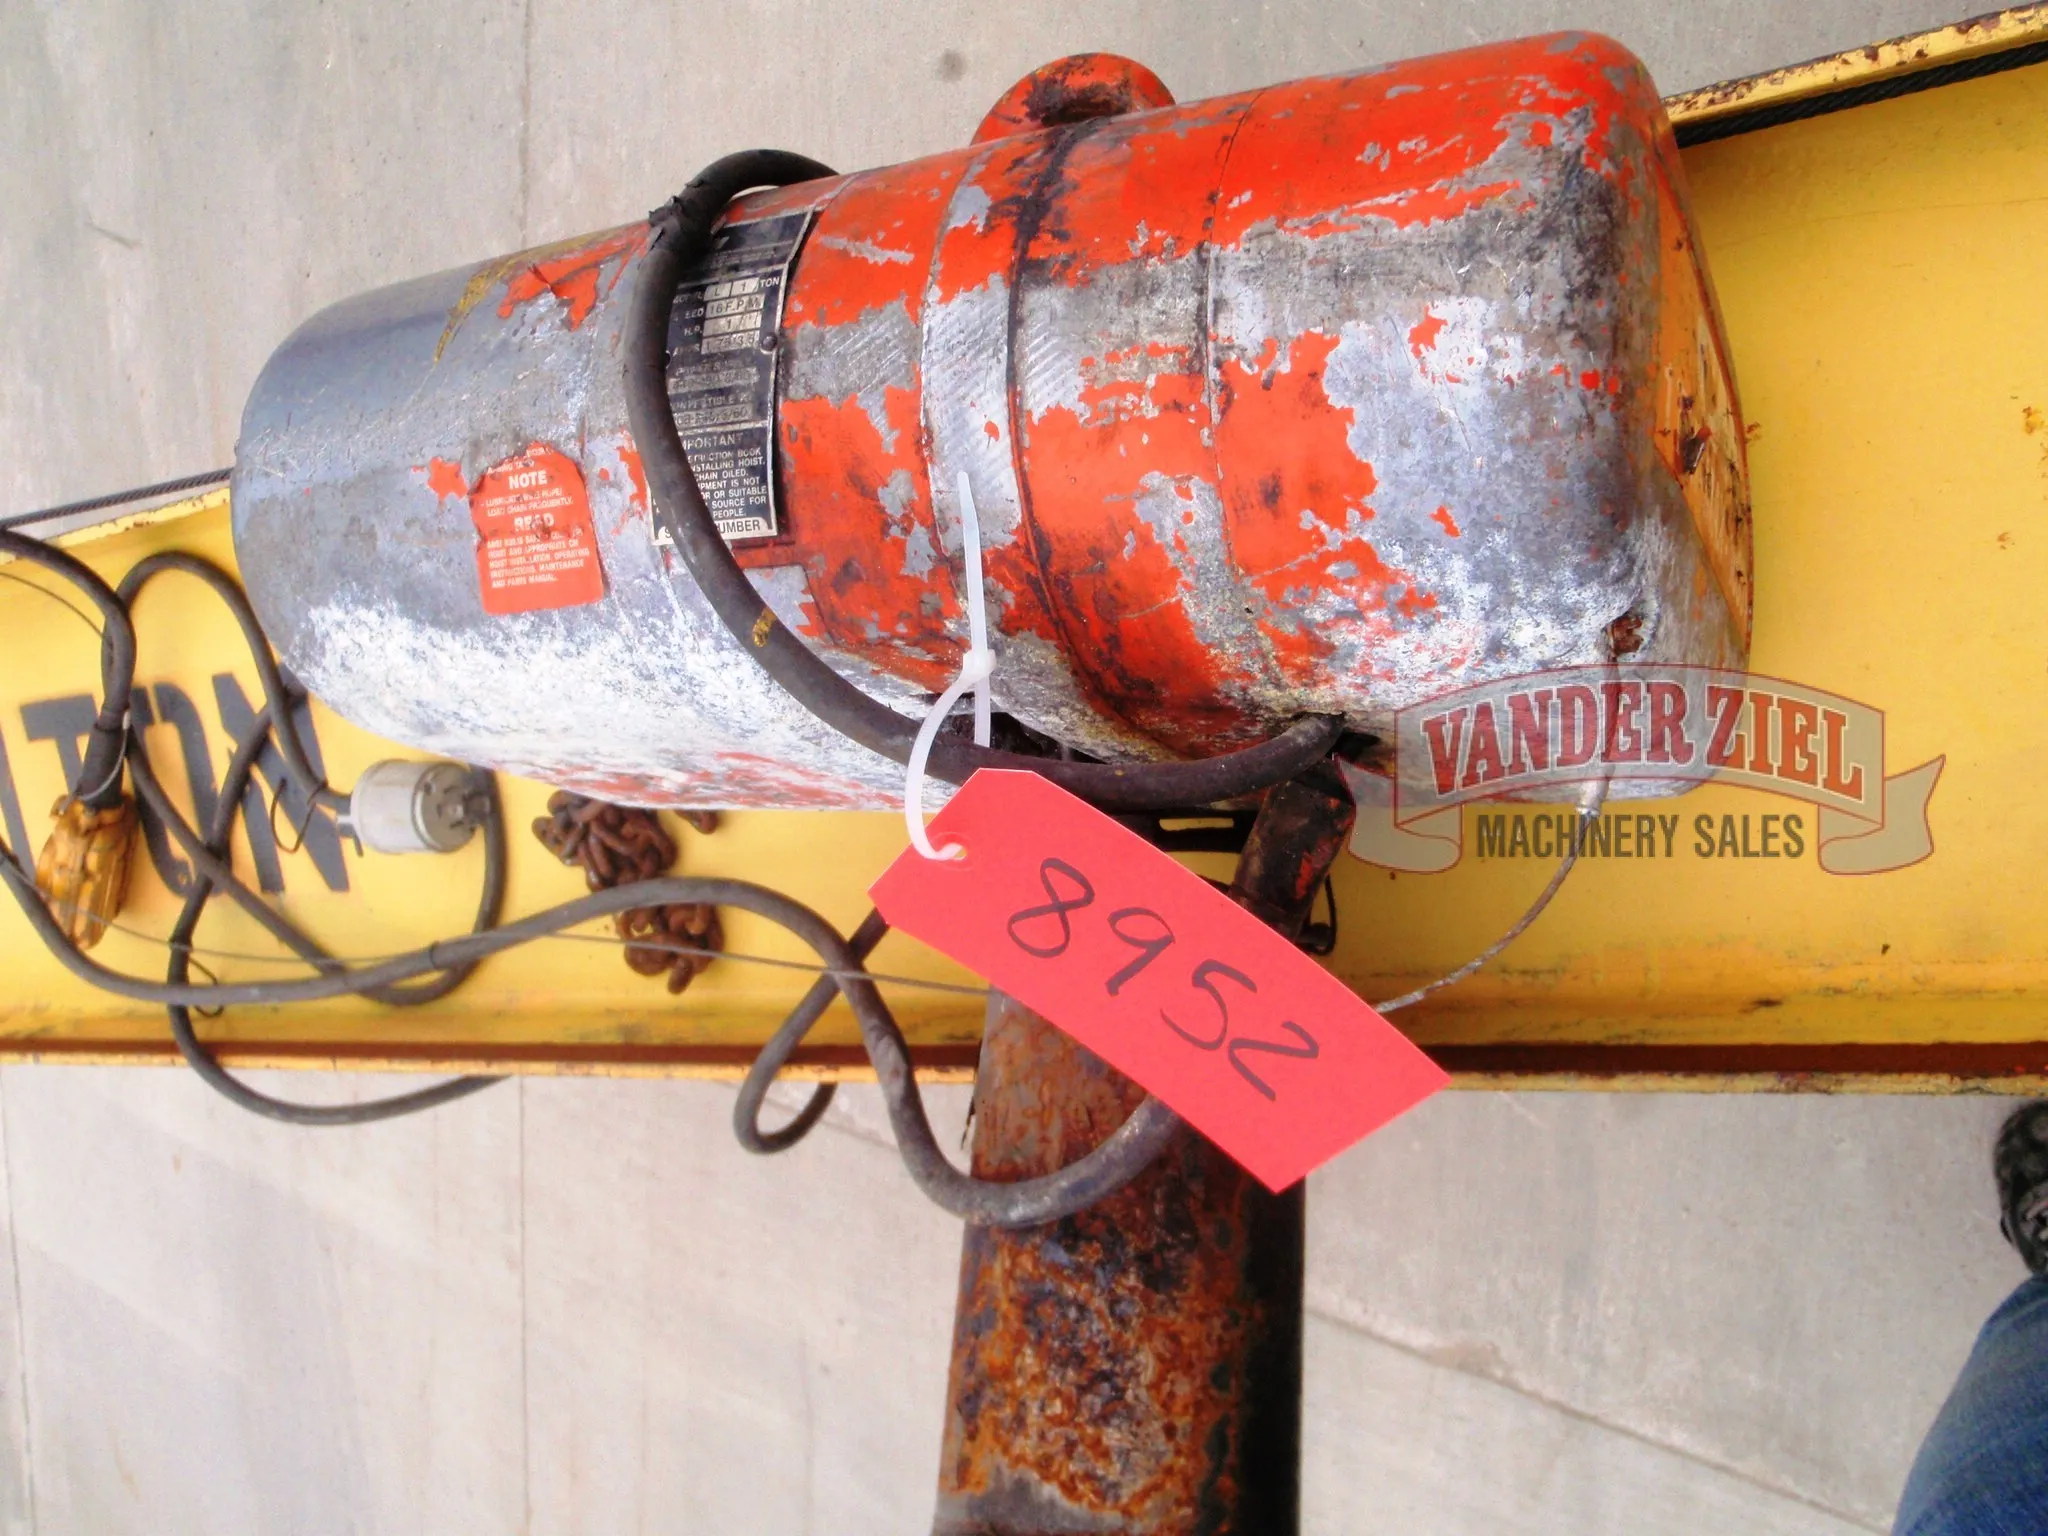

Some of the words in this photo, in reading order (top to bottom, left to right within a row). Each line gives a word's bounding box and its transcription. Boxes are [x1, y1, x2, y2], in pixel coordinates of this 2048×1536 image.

[760, 276, 780, 288] TON
[682, 433, 744, 450] MPORTANT
[737, 447, 762, 457] BOOK
[738, 456, 766, 467] HOIST.
[509, 470, 547, 490] NOTE
[722, 469, 749, 480] OILED.
[730, 478, 740, 487] IS
[743, 476, 761, 486] NOT
[714, 490, 726, 500] OR
[728, 485, 768, 498] SUITABLE
[711, 497, 745, 509] SOURCE
[748, 495, 767, 506] FOR
[712, 508, 747, 519] PEOPLE.
[514, 513, 554, 531] READ
[718, 519, 760, 534] UMBER
[1006, 856, 1320, 1103] 8952
